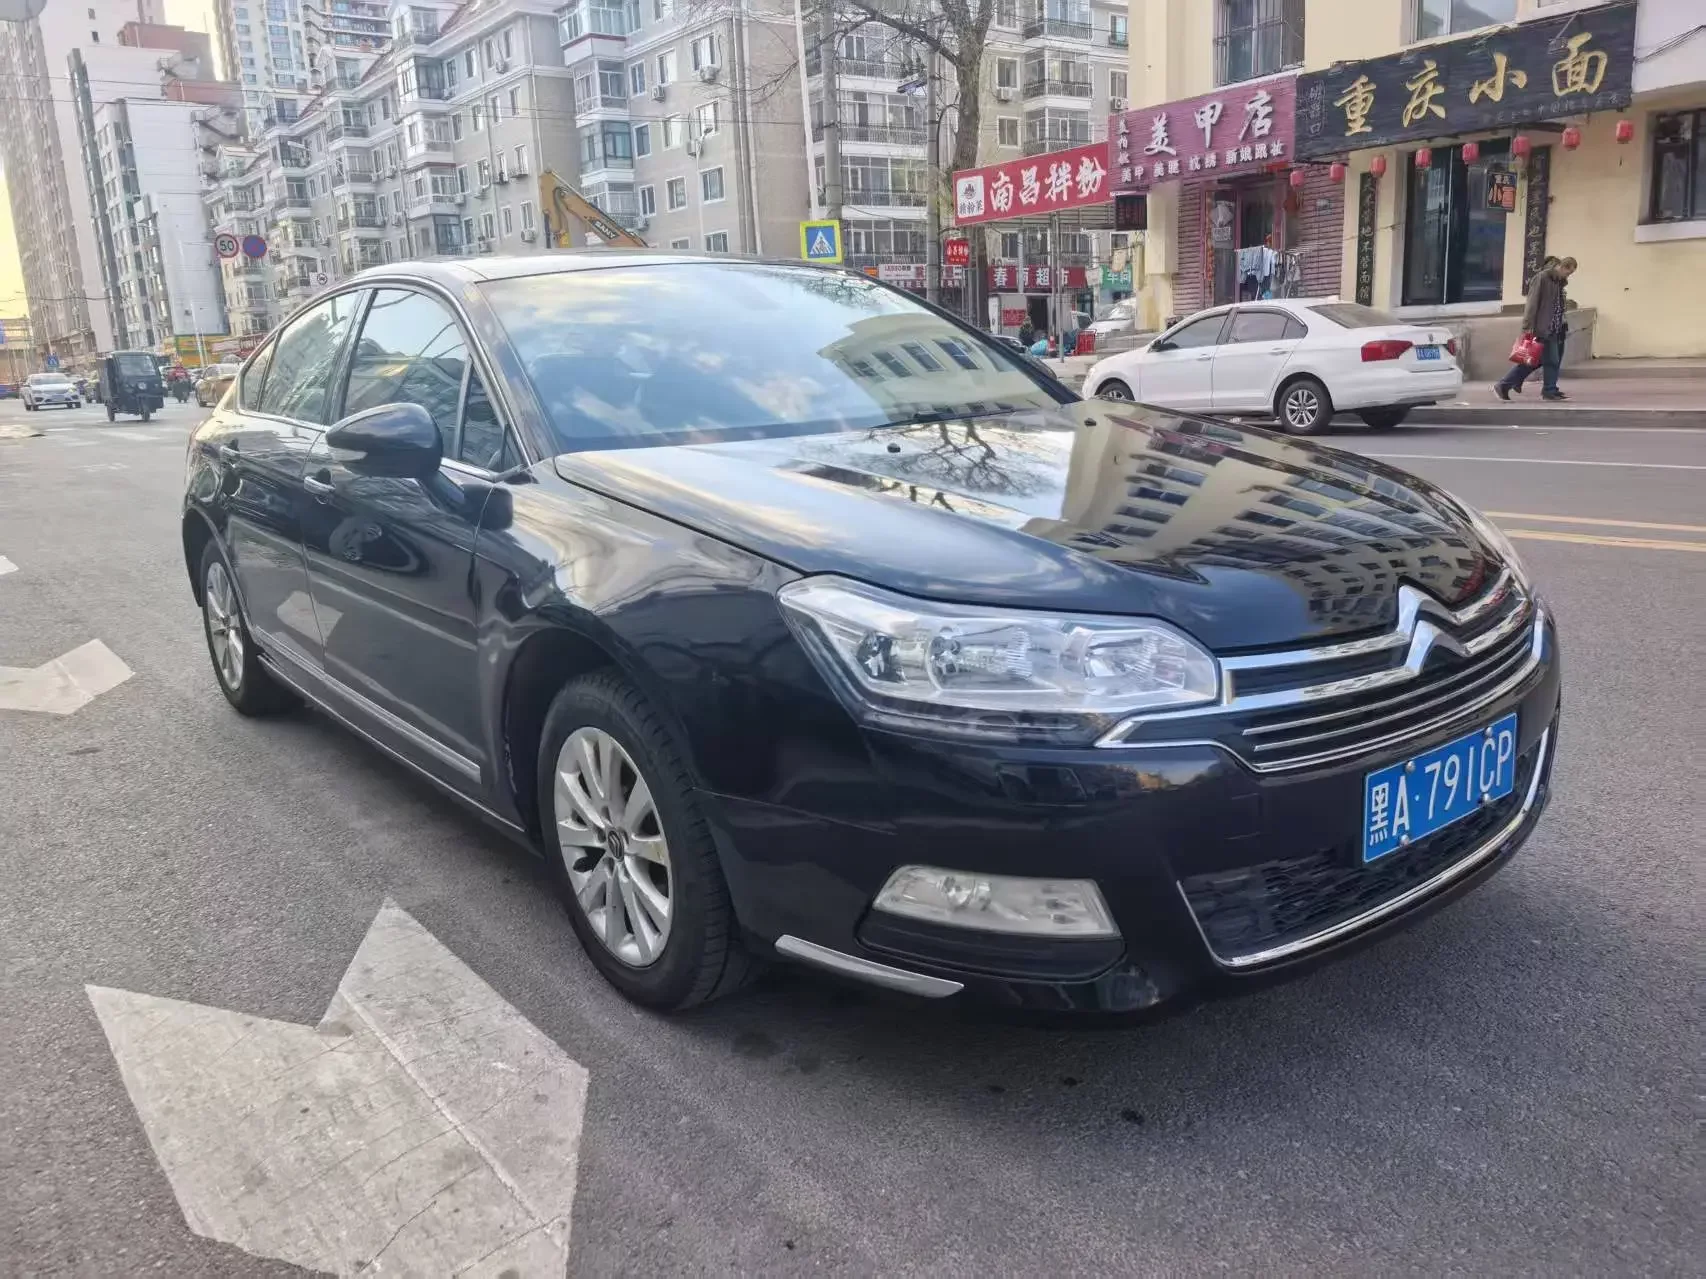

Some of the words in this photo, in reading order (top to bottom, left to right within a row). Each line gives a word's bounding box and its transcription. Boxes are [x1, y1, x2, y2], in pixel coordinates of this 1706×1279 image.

[1333, 32, 1608, 137] 重庆小面
[1143, 90, 1273, 156] 美甲店
[990, 156, 1107, 213] 南昌拌粉
[1121, 165, 1144, 182] 美甲
[1225, 139, 1284, 165] 新娘跟妆
[219, 240, 235, 252] 50
[594, 221, 616, 239] SANY
